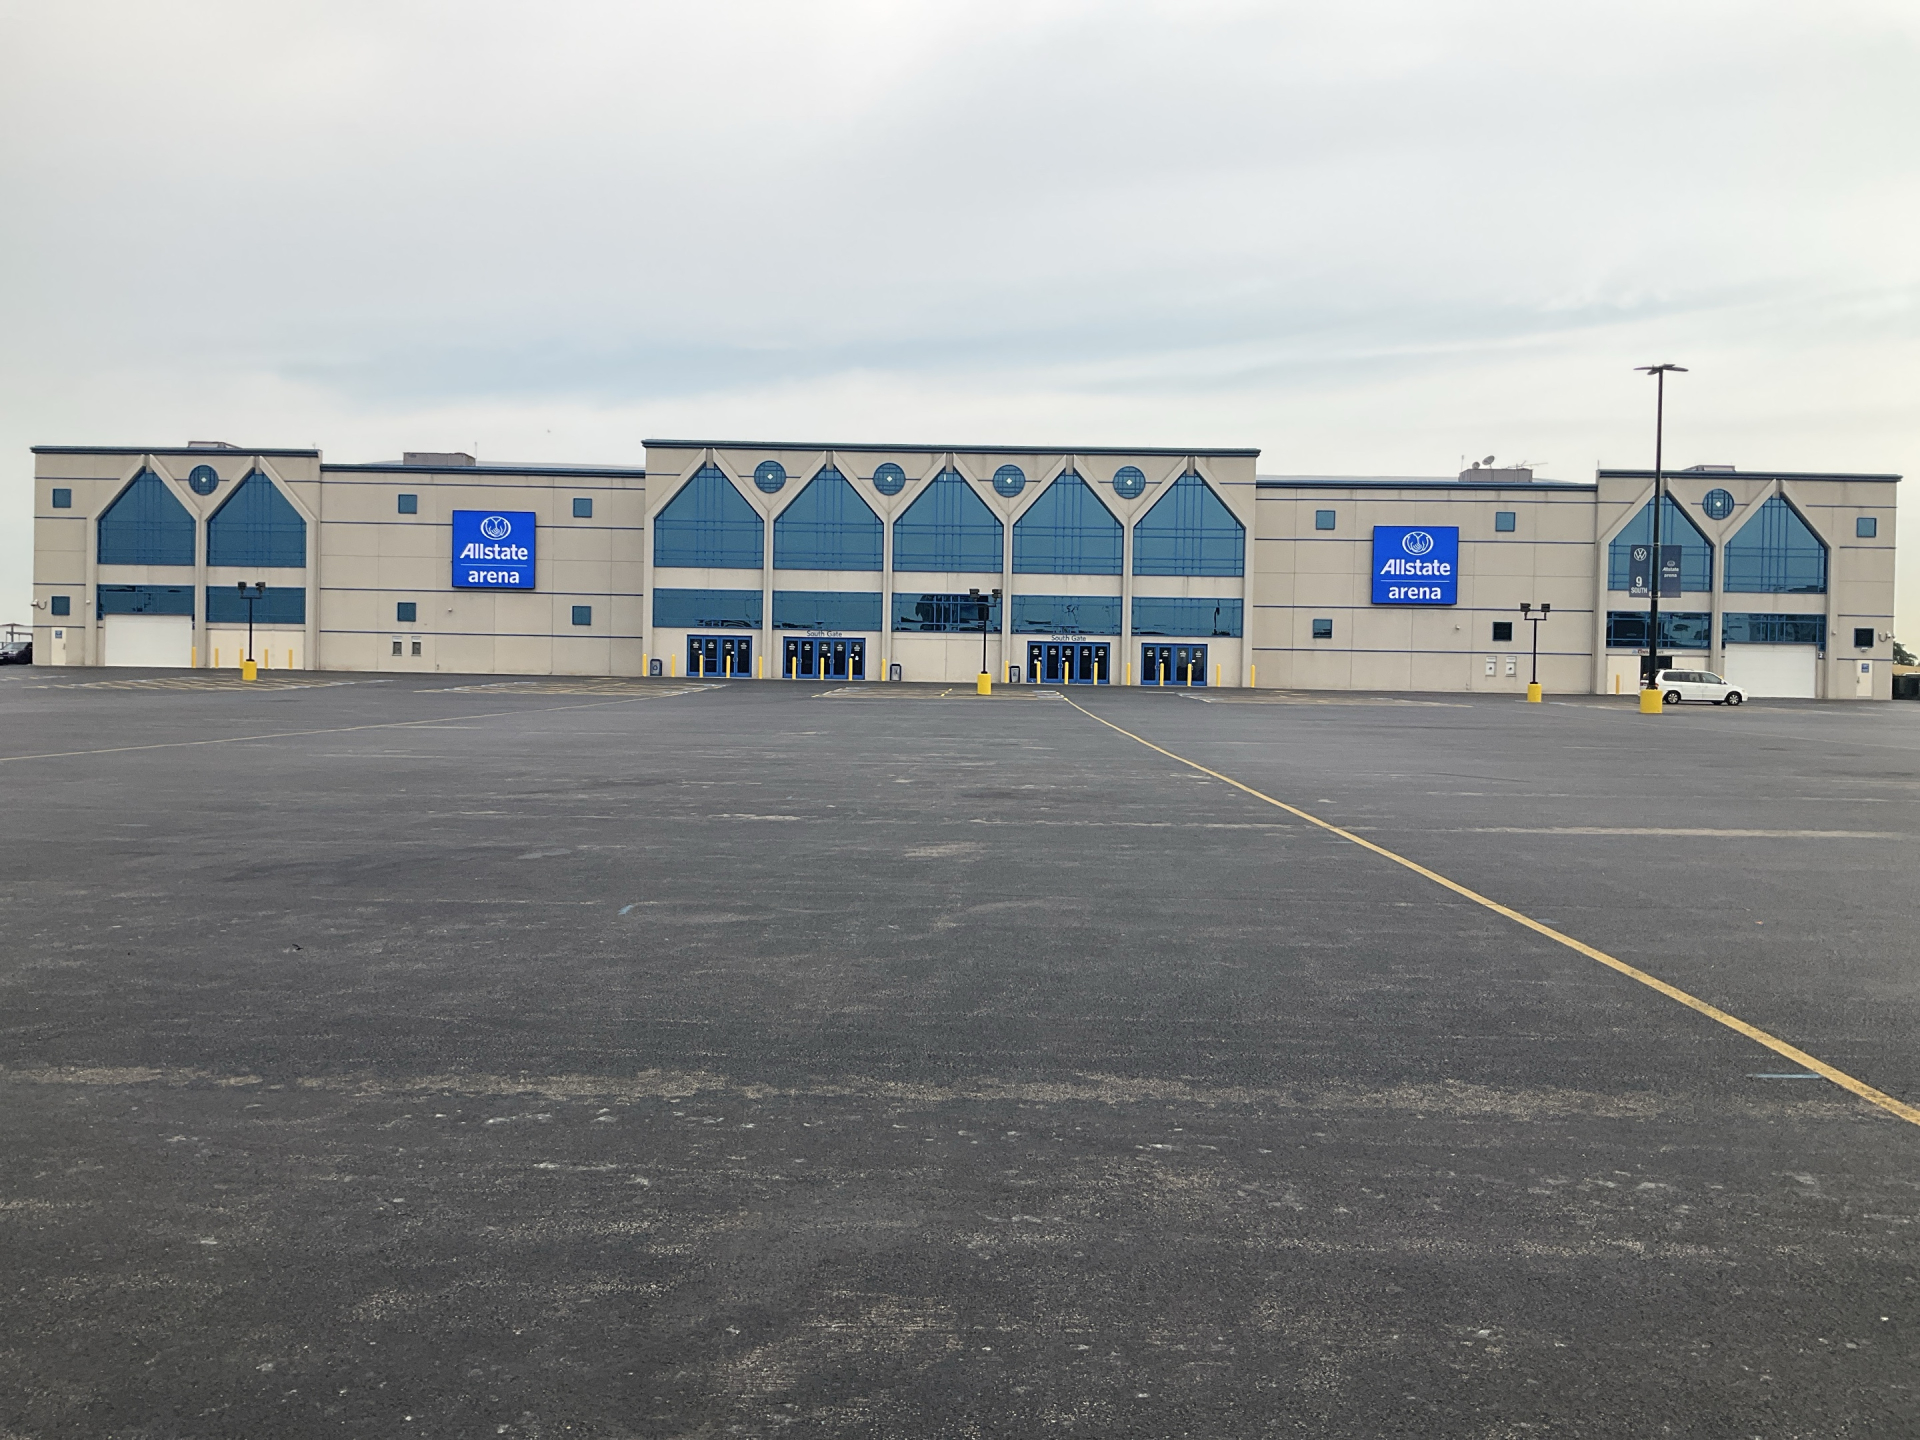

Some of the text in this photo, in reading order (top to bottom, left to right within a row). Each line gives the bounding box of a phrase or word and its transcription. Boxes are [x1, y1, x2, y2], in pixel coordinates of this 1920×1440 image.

[460, 543, 528, 560] Allstate
[1380, 559, 1451, 576] Allstate
[468, 570, 520, 584] arena
[1635, 576, 1643, 587] 9
[1388, 586, 1441, 600] arena
